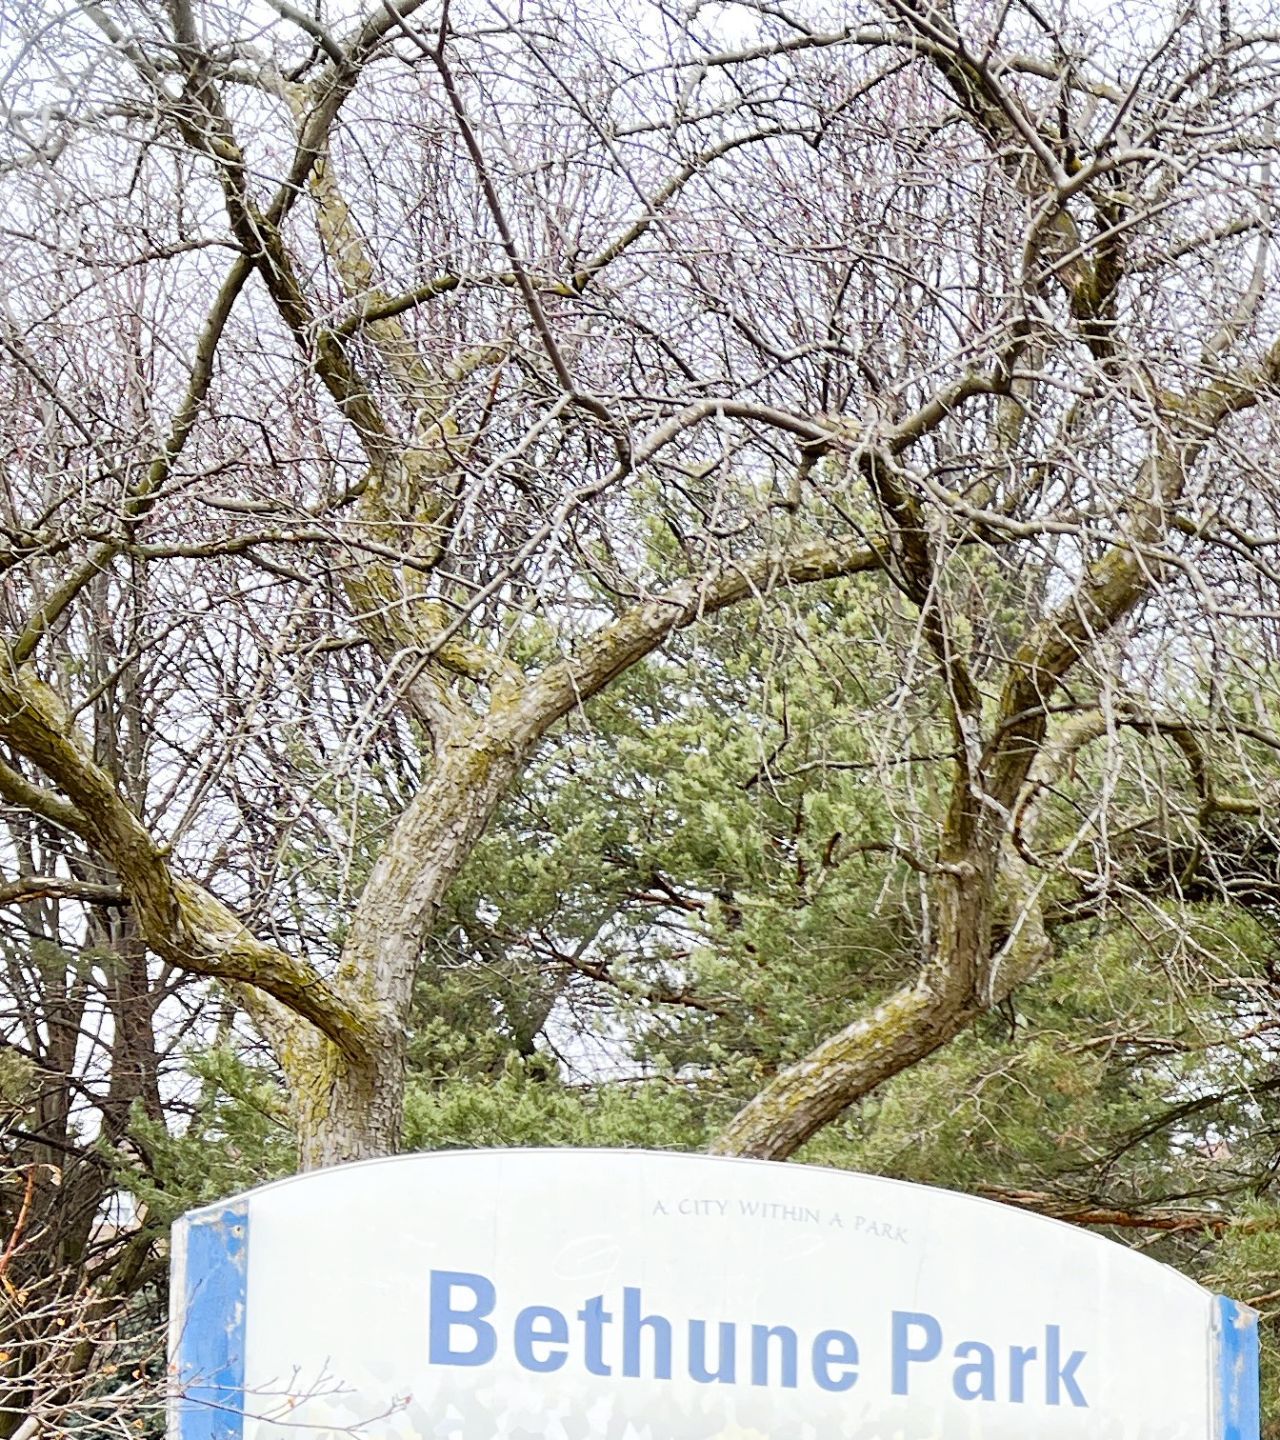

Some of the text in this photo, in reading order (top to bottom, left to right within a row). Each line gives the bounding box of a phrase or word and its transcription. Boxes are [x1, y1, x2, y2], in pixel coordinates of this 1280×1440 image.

[653, 1198, 909, 1244] A CITY WITHIN A PARK
[428, 1269, 1090, 1408] Bethune Park
